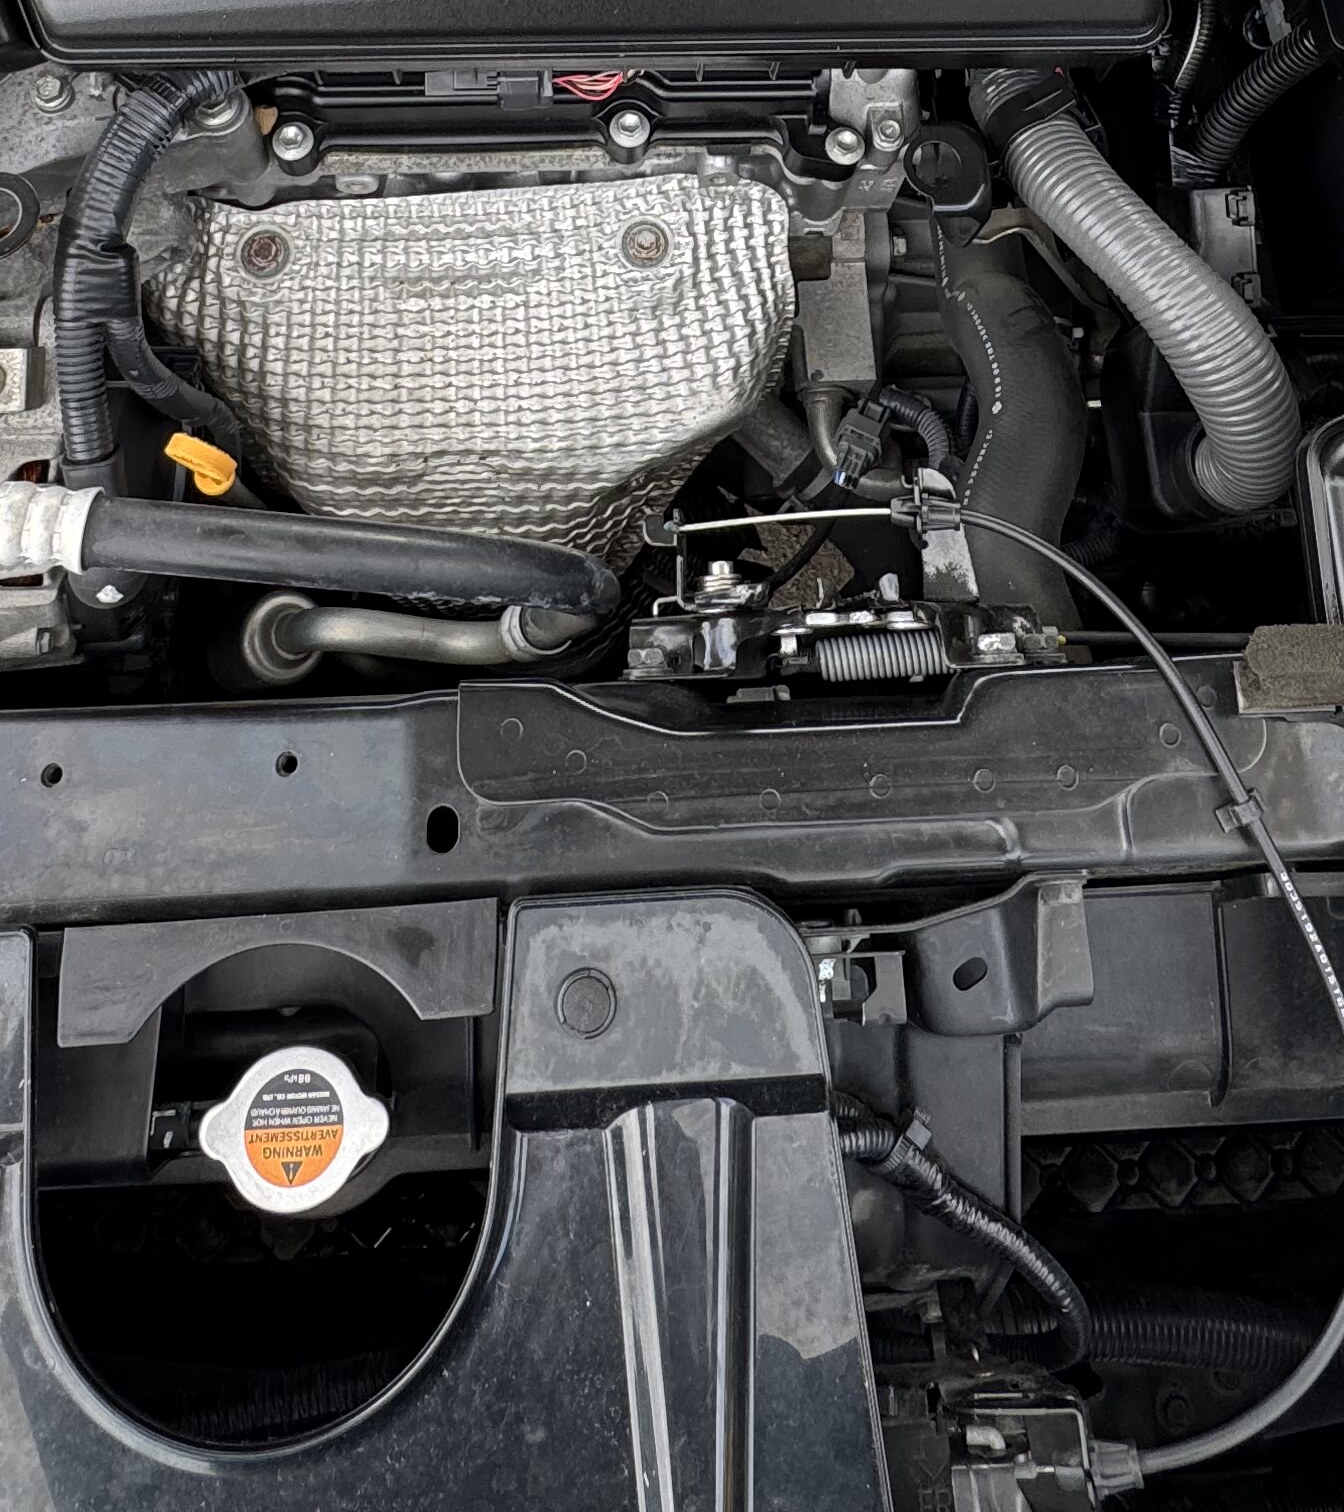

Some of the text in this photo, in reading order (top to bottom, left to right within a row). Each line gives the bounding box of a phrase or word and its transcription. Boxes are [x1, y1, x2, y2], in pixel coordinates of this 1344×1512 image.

[269, 1117, 291, 1127] WHEN
[292, 1115, 312, 1125] OPEN
[314, 1114, 338, 1124] NEVER
[248, 1129, 339, 1144] AVERTISSEMENT
[262, 1144, 323, 1159] WARNING
